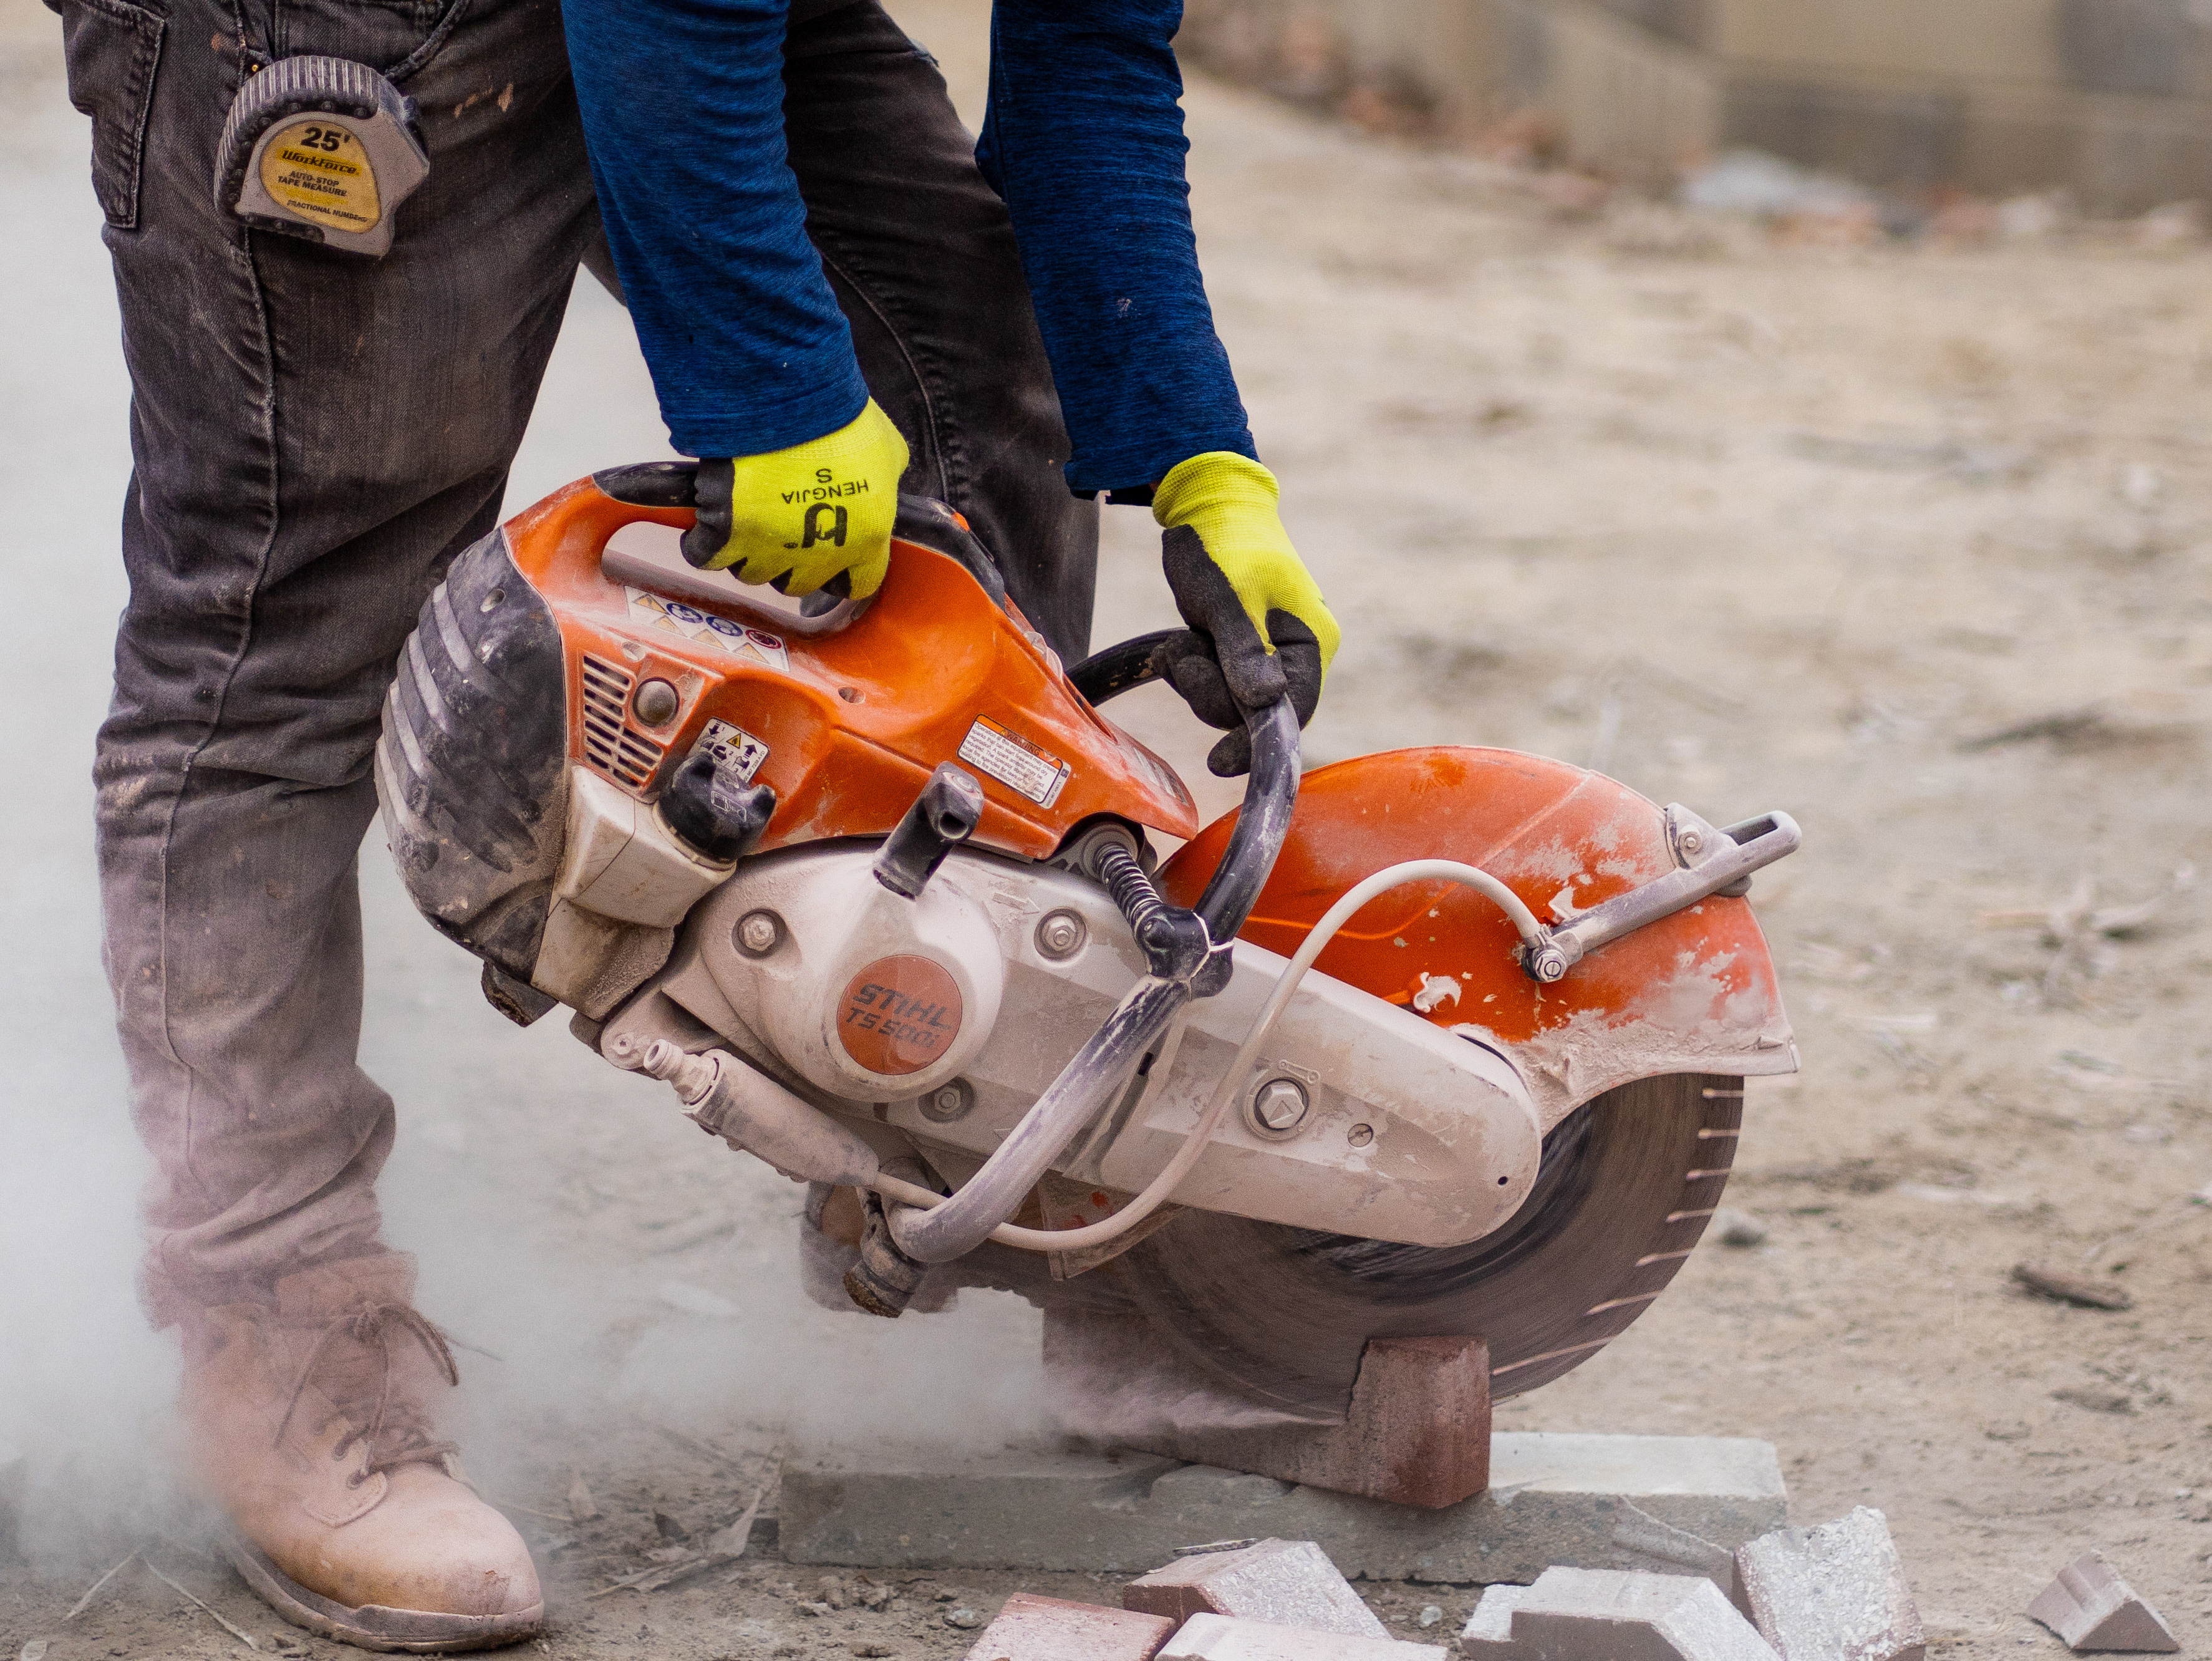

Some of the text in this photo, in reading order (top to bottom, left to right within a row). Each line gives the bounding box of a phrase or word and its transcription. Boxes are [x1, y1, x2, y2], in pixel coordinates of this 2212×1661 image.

[301, 127, 350, 152] 25'
[281, 150, 357, 175] WorkForce
[278, 175, 347, 196] TAPE MEASURE
[289, 170, 340, 186] AUTO-STOP
[287, 200, 331, 214] FRACTIONAL
[815, 468, 833, 483] S
[781, 479, 869, 504] HENGJIA
[970, 728, 987, 740] sparks
[986, 737, 995, 745] that
[1004, 747, 1015, 756] start
[1014, 753, 1025, 762] fires
[1024, 759, 1041, 771] around
[1040, 768, 1048, 777] dry
[973, 722, 997, 738] Operation
[1001, 738, 1010, 746] this
[1010, 743, 1033, 760] equipment
[1032, 757, 1043, 766] may
[1042, 763, 1058, 774] create
[958, 748, 977, 762] relating
[988, 767, 1012, 783] prevention
[962, 743, 973, 753] local
[980, 754, 1000, 769] agencies
[1007, 770, 1018, 779] laws
[985, 749, 995, 758] The
[993, 755, 1013, 769] operator
[1013, 767, 1028, 778] should
[996, 750, 1009, 760] spark
[1008, 757, 1026, 770] arrester
[1025, 768, 1036, 777] may
[846, 1007, 881, 1030] TS
[852, 983, 951, 1030] STIHL
